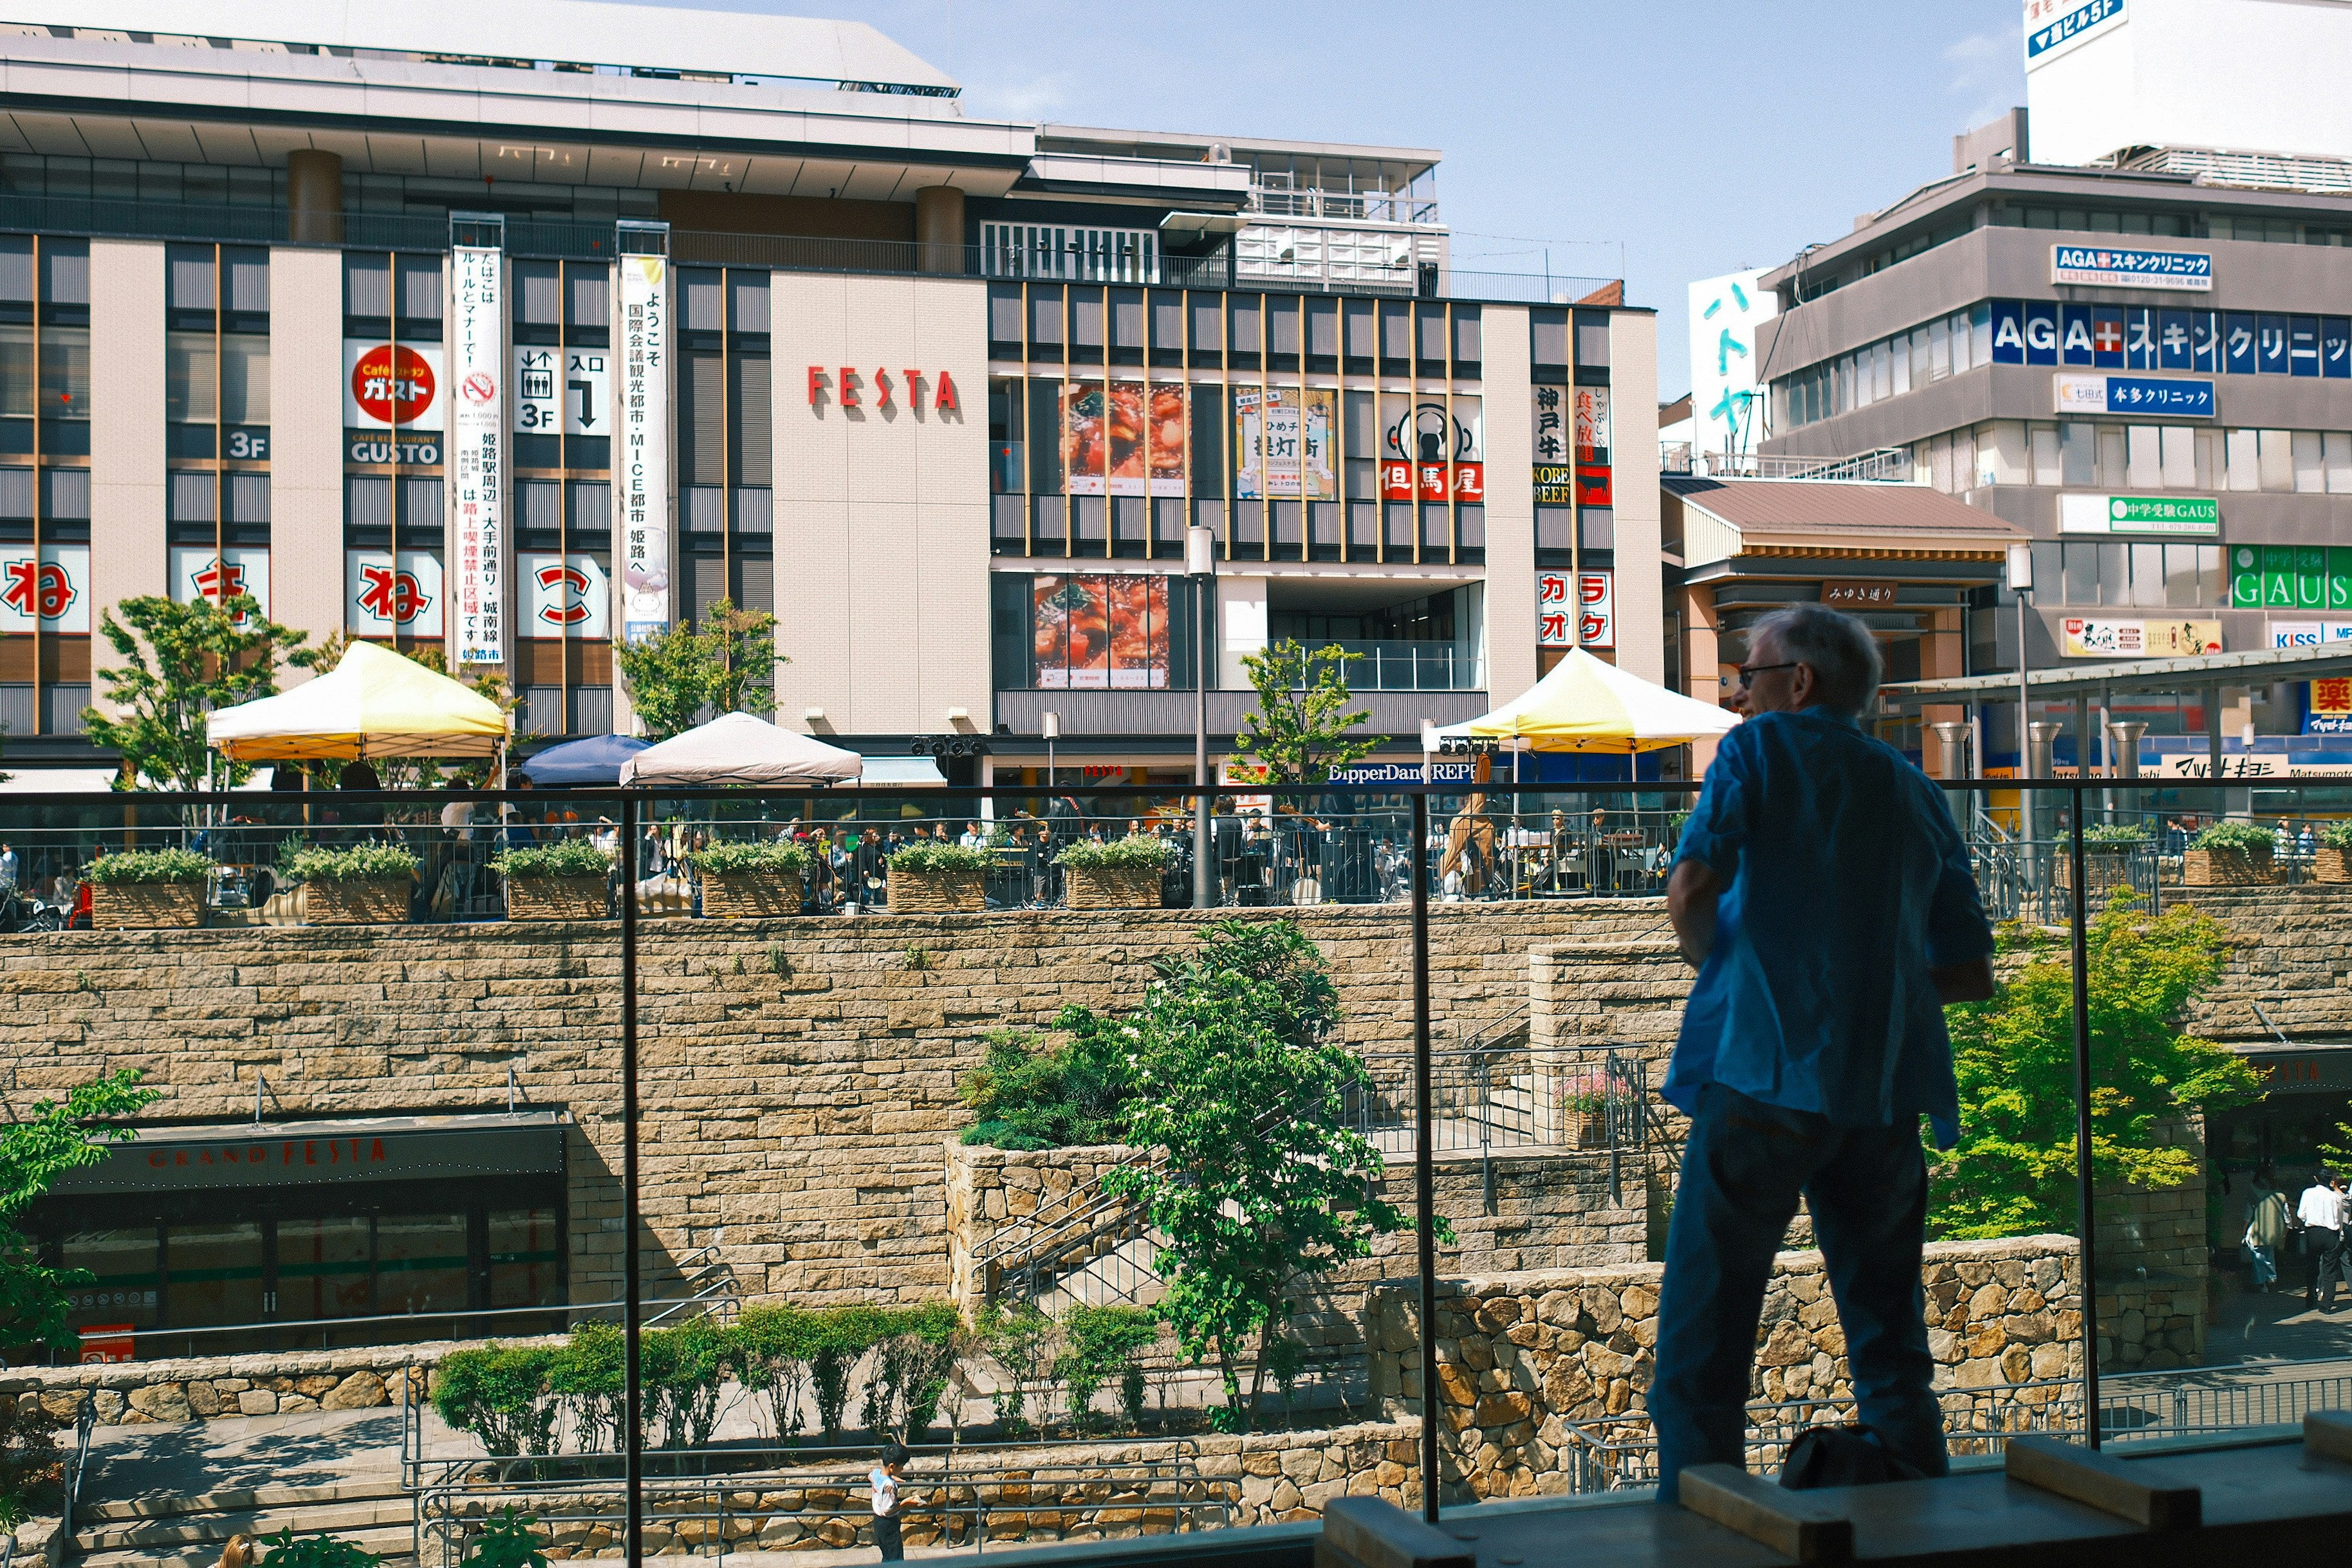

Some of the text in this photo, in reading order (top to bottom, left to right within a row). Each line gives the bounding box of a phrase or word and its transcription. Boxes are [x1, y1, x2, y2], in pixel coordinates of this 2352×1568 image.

[2051, 0, 2114, 44] 当ビル5F
[2060, 250, 2208, 274] AGA スキンクリニック
[646, 292, 662, 367] ようこそ
[1994, 316, 2093, 351] AGA
[569, 355, 604, 373] 入口
[1703, 282, 1751, 434] ハトヤ
[364, 378, 428, 401] ガスト
[808, 366, 956, 409] FESTA
[2115, 386, 2208, 406] 本多クリニック
[521, 404, 553, 428] 3F
[1537, 387, 1561, 459] 神戸牛
[229, 431, 264, 459] 3F
[351, 442, 438, 464] GUSTO
[1381, 466, 1483, 493] 但馬屋
[1533, 467, 1570, 484] KOBE
[1533, 486, 1569, 503] BEEF
[2266, 551, 2323, 567] 中学受験
[1, 558, 78, 620] ね
[357, 563, 432, 625] ね
[535, 564, 591, 625] こ
[1829, 587, 1891, 602] みゆき通り
[2235, 572, 2347, 605] GAUS
[463, 649, 499, 659] 姫路市
[2317, 678, 2350, 710] 薬
[1085, 766, 1122, 777] FESTA
[2176, 757, 2275, 778] マツトキヨシ
[149, 1138, 385, 1168] GRAND FESTA
